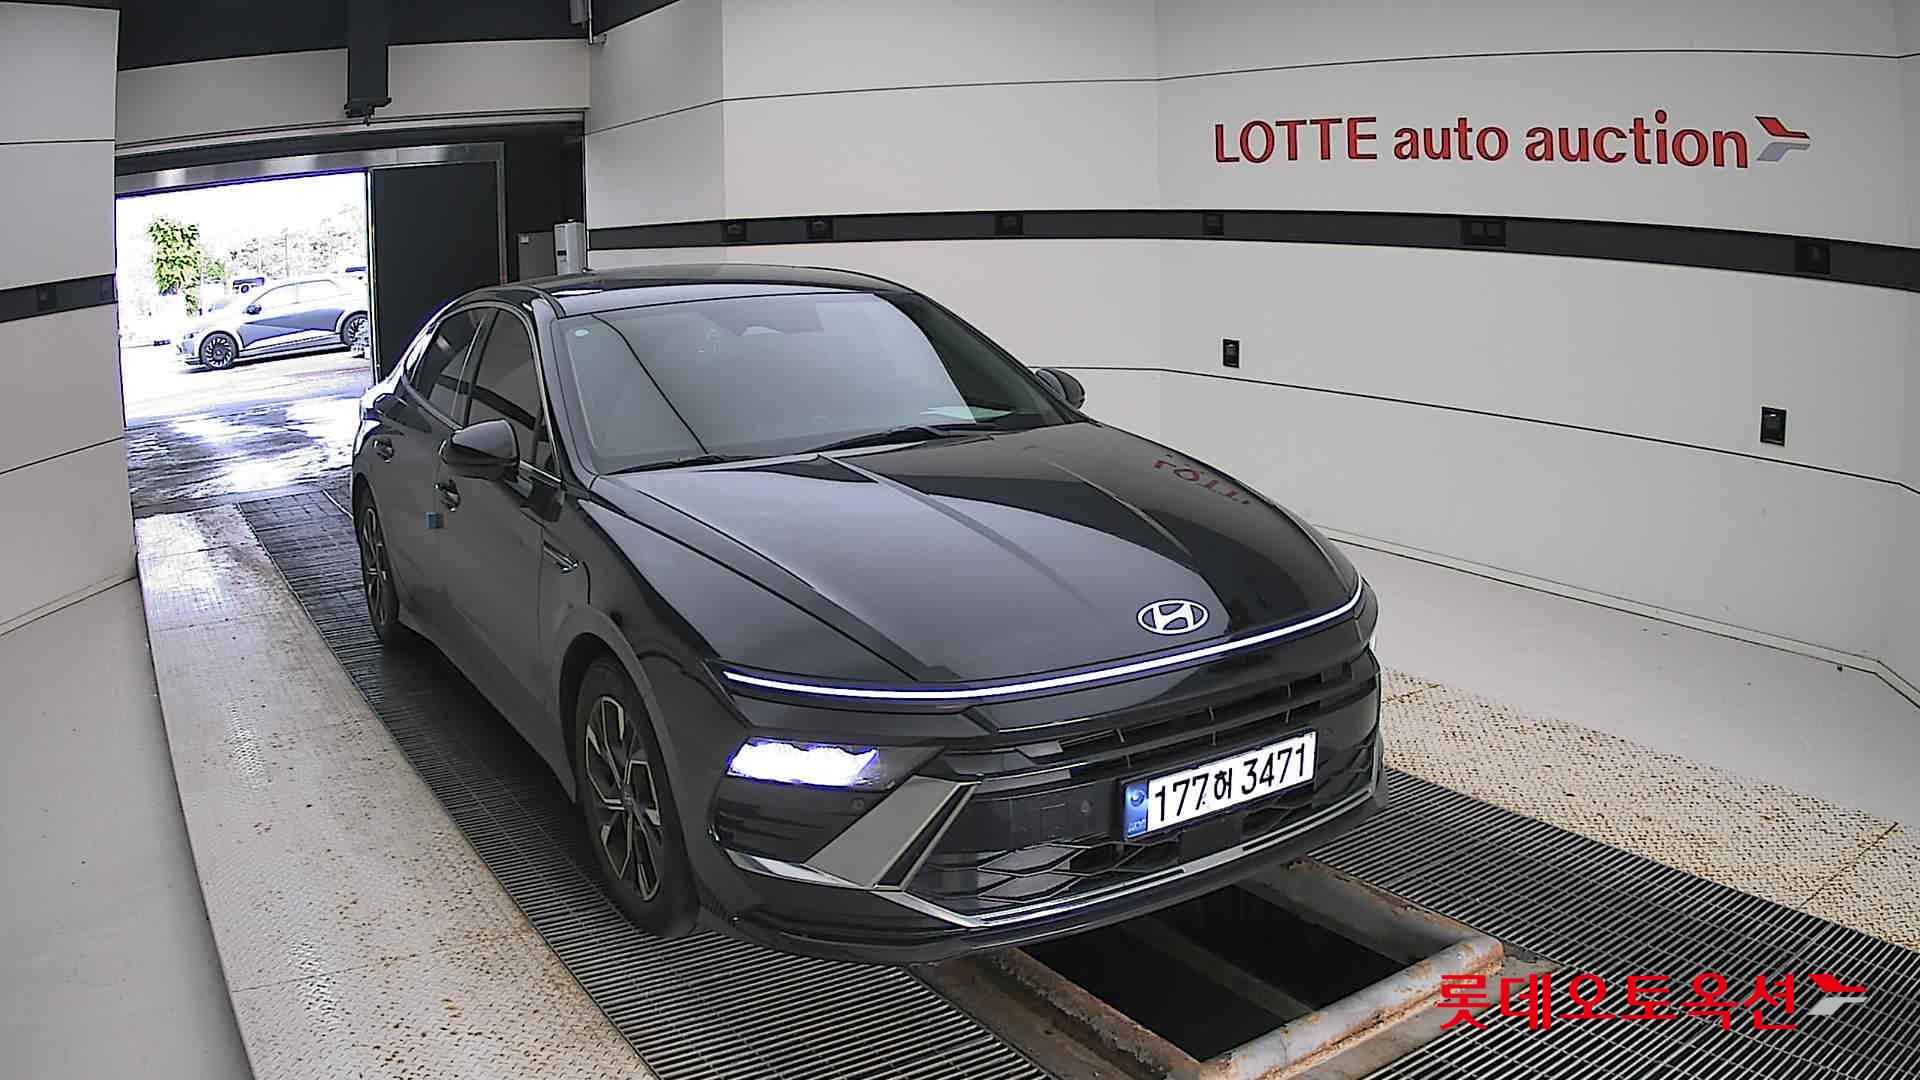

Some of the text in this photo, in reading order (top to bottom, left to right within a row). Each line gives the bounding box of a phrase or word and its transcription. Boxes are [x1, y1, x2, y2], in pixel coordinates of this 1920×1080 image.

[1215, 110, 1749, 168] LOTTE auto auction
[1154, 742, 1305, 821] 177허 3471
